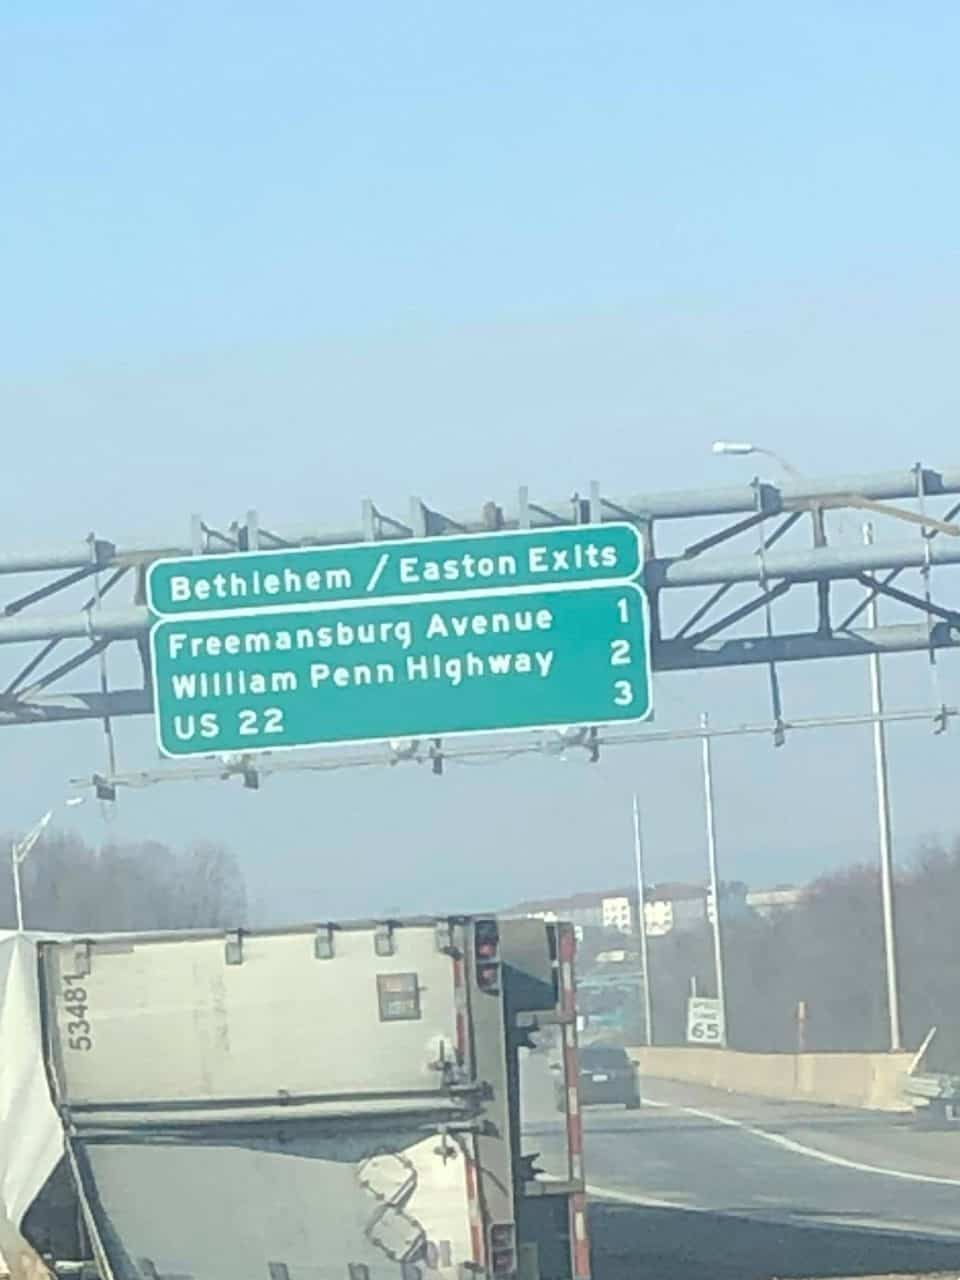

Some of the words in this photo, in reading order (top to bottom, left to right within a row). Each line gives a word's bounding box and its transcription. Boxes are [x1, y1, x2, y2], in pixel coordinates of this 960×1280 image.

[170, 568, 352, 601] Bethlehem
[366, 553, 389, 592] /
[399, 554, 516, 583] Easton
[529, 543, 618, 573] Exits
[169, 620, 412, 659] Freemansburg
[426, 608, 553, 639] Avenue
[617, 598, 629, 623] 1
[172, 669, 297, 700] William
[310, 663, 394, 689] Penn
[406, 650, 554, 686] Highway
[610, 639, 632, 665] 2
[174, 712, 220, 740] US
[238, 707, 284, 735] 22
[613, 680, 633, 706] 3
[63, 974, 92, 1052] 53481
[691, 1022, 720, 1039] 65
